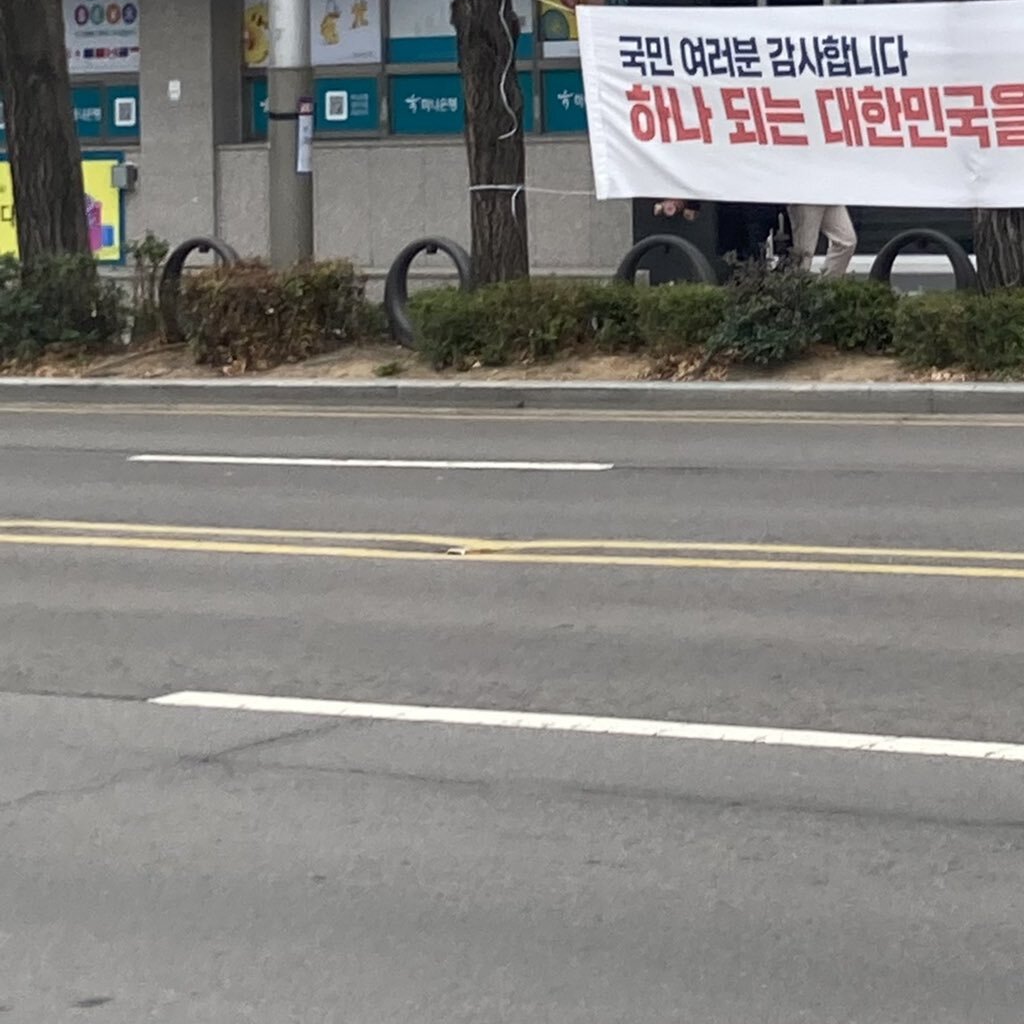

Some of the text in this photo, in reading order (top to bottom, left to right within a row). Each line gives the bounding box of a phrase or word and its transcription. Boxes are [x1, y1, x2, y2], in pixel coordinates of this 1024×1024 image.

[619, 35, 908, 77] 국민 여러분 감사합니다
[626, 83, 712, 143] 하나
[720, 86, 808, 145] 되는
